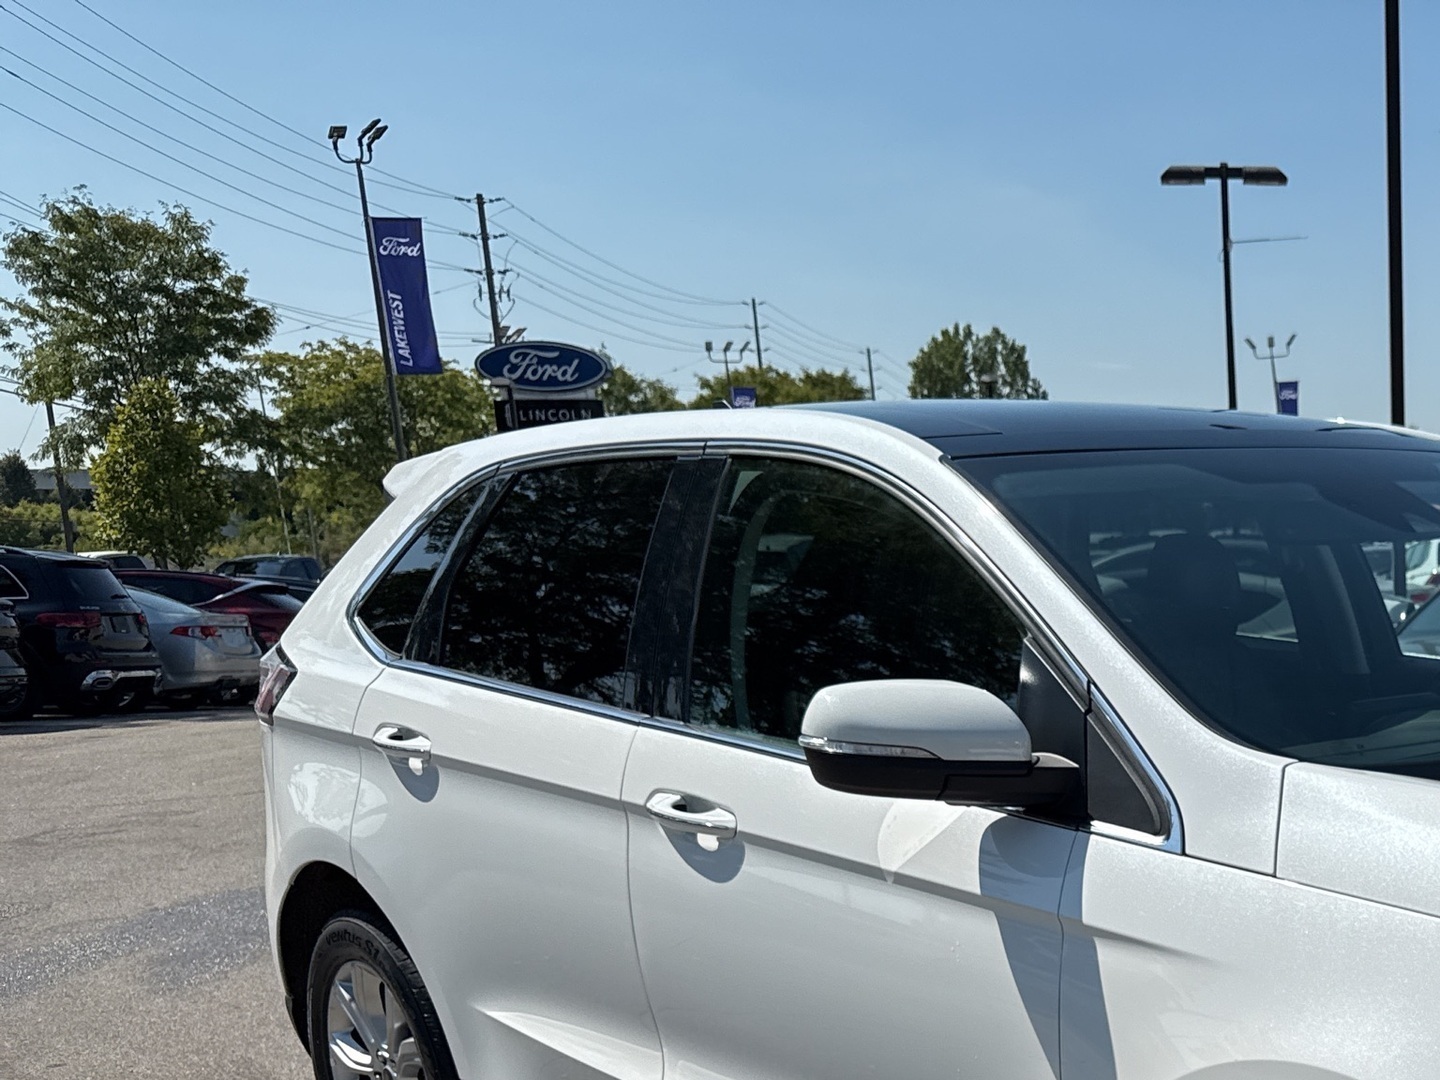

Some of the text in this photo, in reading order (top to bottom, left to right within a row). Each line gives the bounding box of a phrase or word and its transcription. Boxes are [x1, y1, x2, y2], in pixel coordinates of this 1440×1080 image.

[379, 236, 421, 257] Ford
[387, 290, 413, 367] LAKEWEST
[502, 349, 580, 383] Ford
[519, 408, 592, 421] LINCOLN
